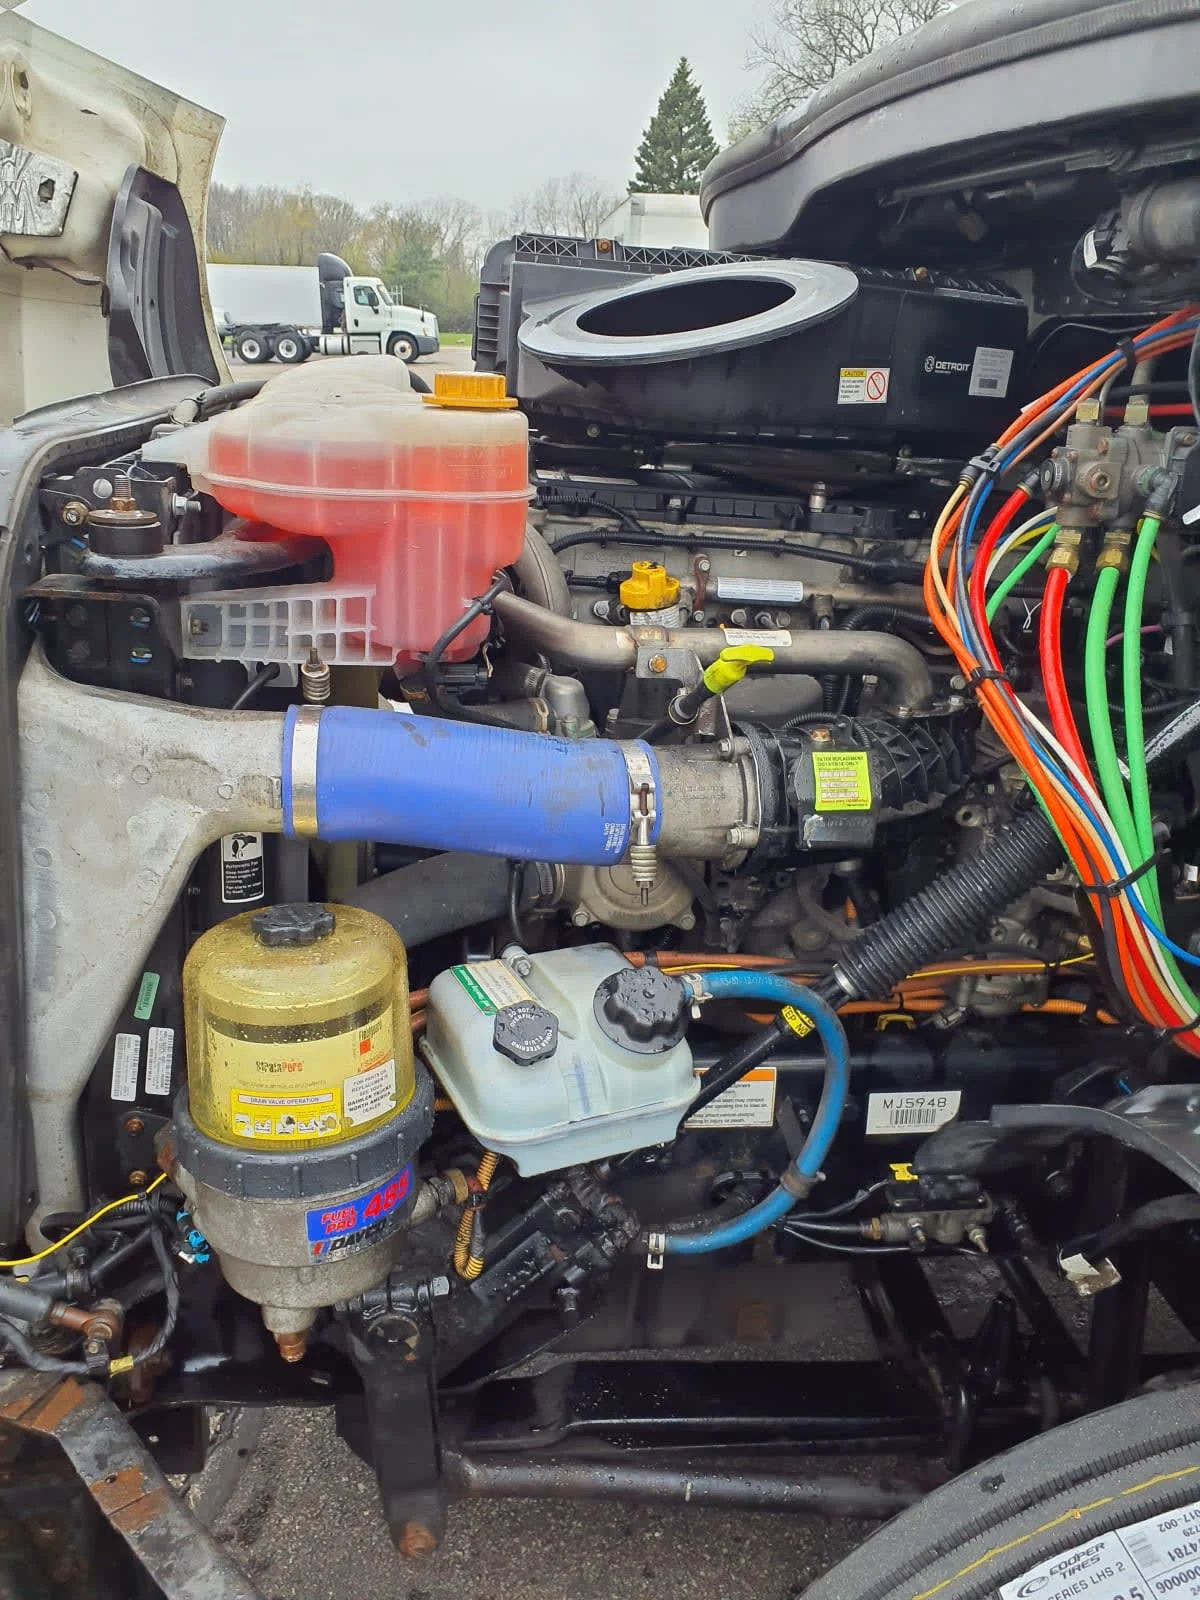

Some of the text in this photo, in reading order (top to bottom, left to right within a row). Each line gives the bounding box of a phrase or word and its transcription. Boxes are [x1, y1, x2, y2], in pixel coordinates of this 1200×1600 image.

[935, 360, 971, 371] DETROIT
[510, 1013, 535, 1027] OVERFILL
[511, 1029, 553, 1052] POWER STEERING
[524, 1035, 543, 1046] FLUID
[347, 1084, 391, 1106] DAIMLER TRUCKS
[349, 1102, 369, 1112] NORTH
[370, 1090, 390, 1104] AMERICA
[322, 1206, 356, 1223] FUEL
[326, 1216, 356, 1233] PRO
[1181, 1524, 1200, 1538] 729
[1049, 1542, 1105, 1576] COOPER
[1167, 1539, 1200, 1562] 4781
[1059, 1555, 1101, 1580] TIRES
[1090, 1566, 1115, 1585] LHS
[1115, 1560, 1126, 1573] 2
